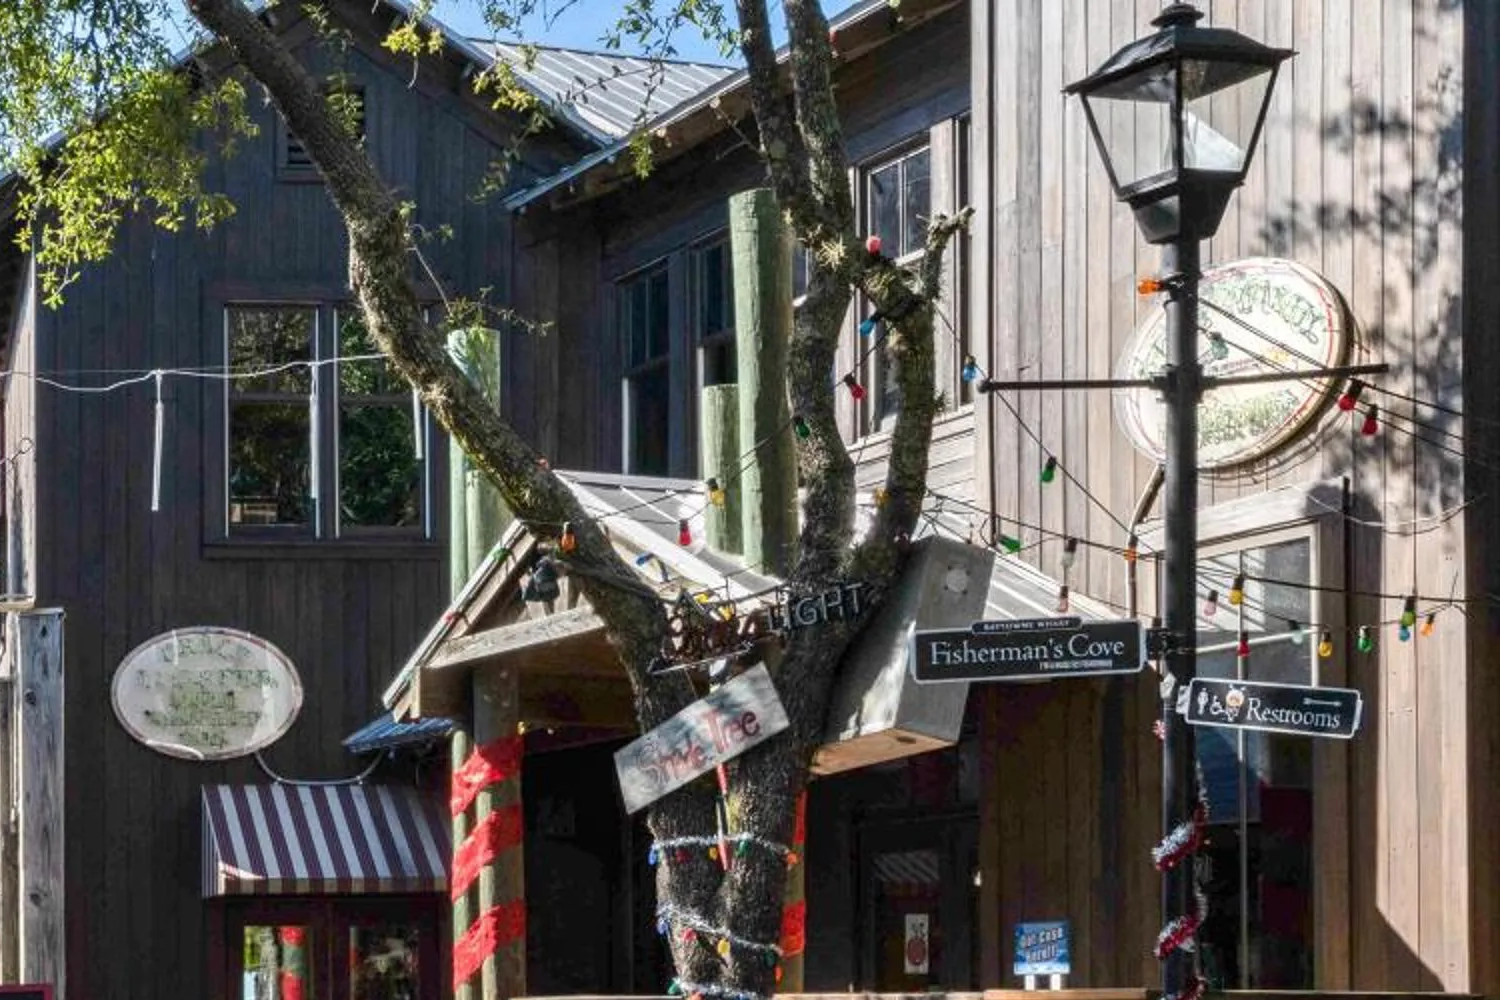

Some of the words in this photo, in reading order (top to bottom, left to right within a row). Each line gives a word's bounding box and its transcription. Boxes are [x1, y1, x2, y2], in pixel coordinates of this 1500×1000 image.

[931, 640, 1064, 665] Fisherman's
[1068, 633, 1125, 658] Cove
[1247, 697, 1341, 728] Restrooms
[703, 706, 761, 754] Tree
